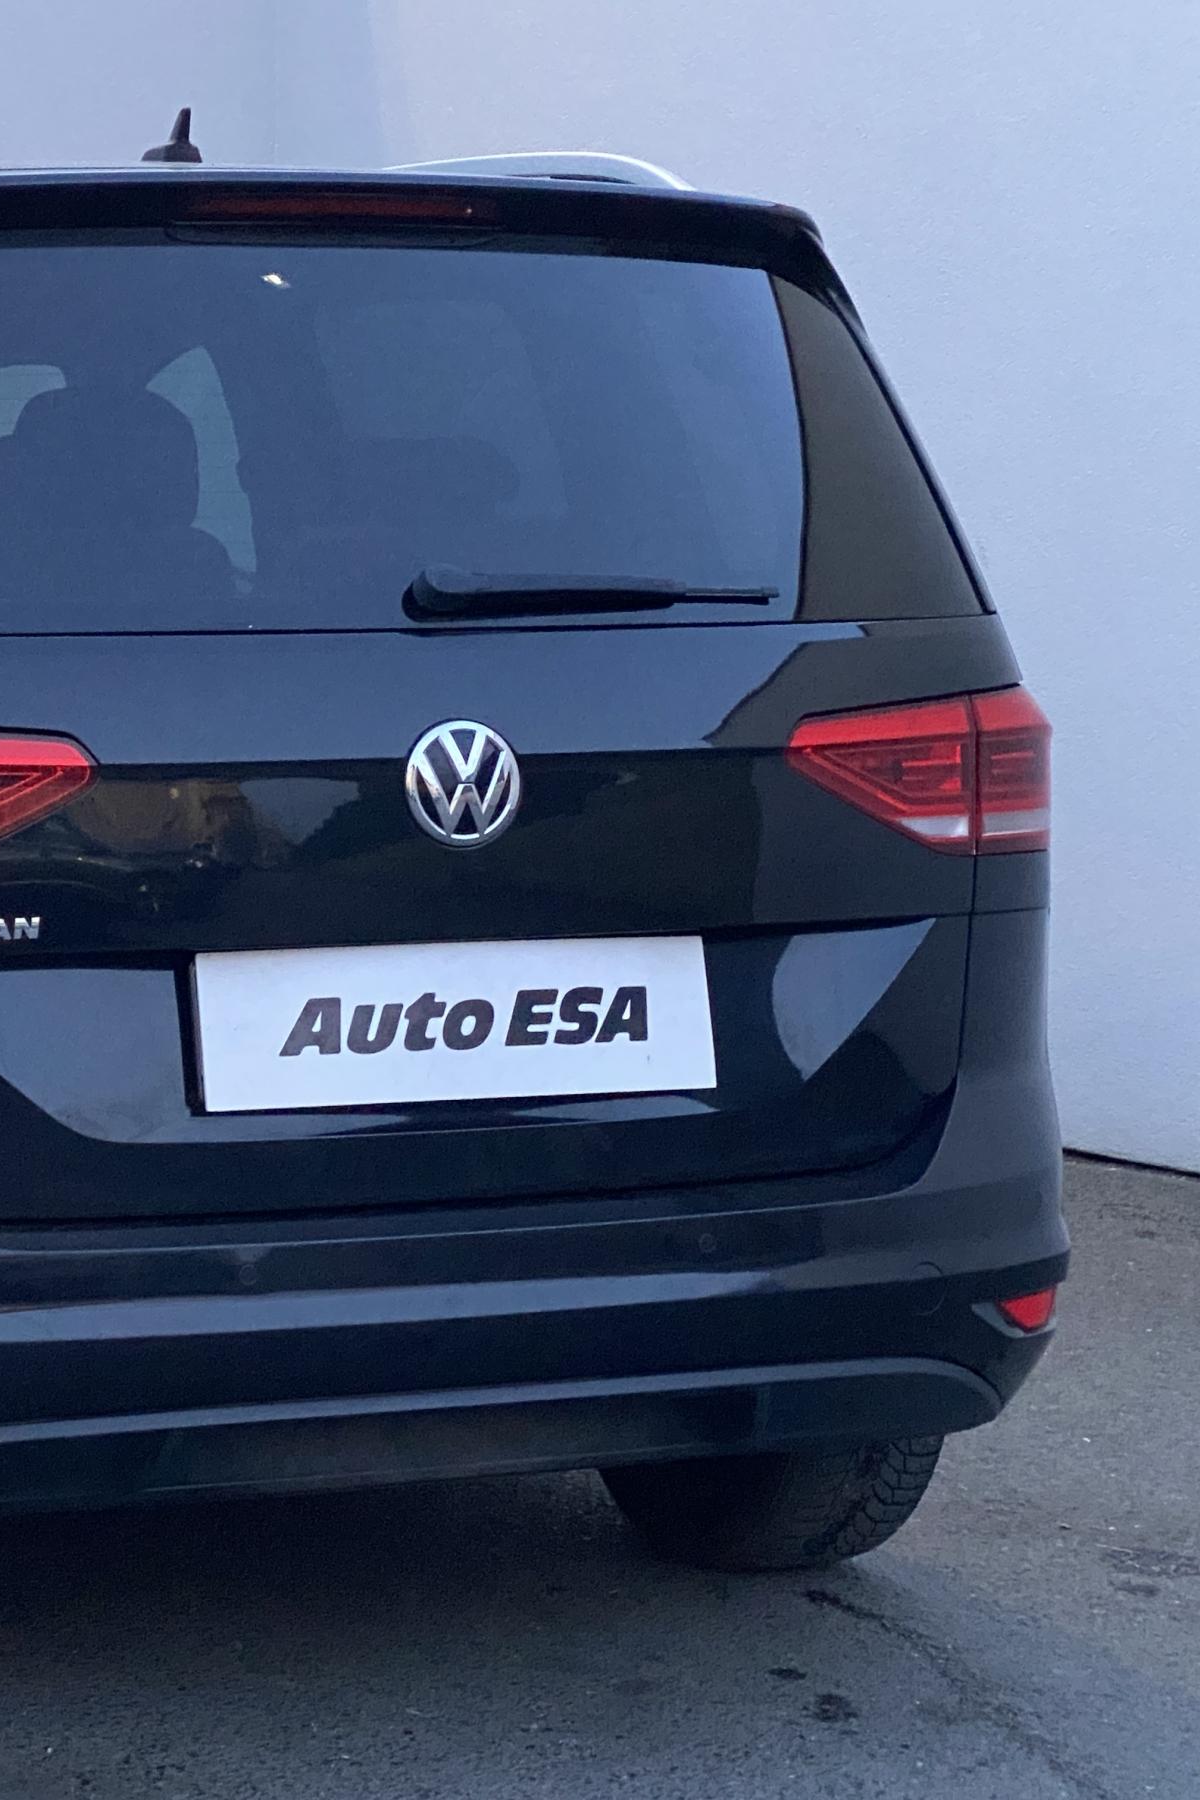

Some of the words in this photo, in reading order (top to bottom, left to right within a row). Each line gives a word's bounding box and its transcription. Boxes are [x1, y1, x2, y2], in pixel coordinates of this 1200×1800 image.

[406, 720, 519, 844] VW
[280, 992, 495, 1057] Auto
[504, 986, 649, 1047] ESA
